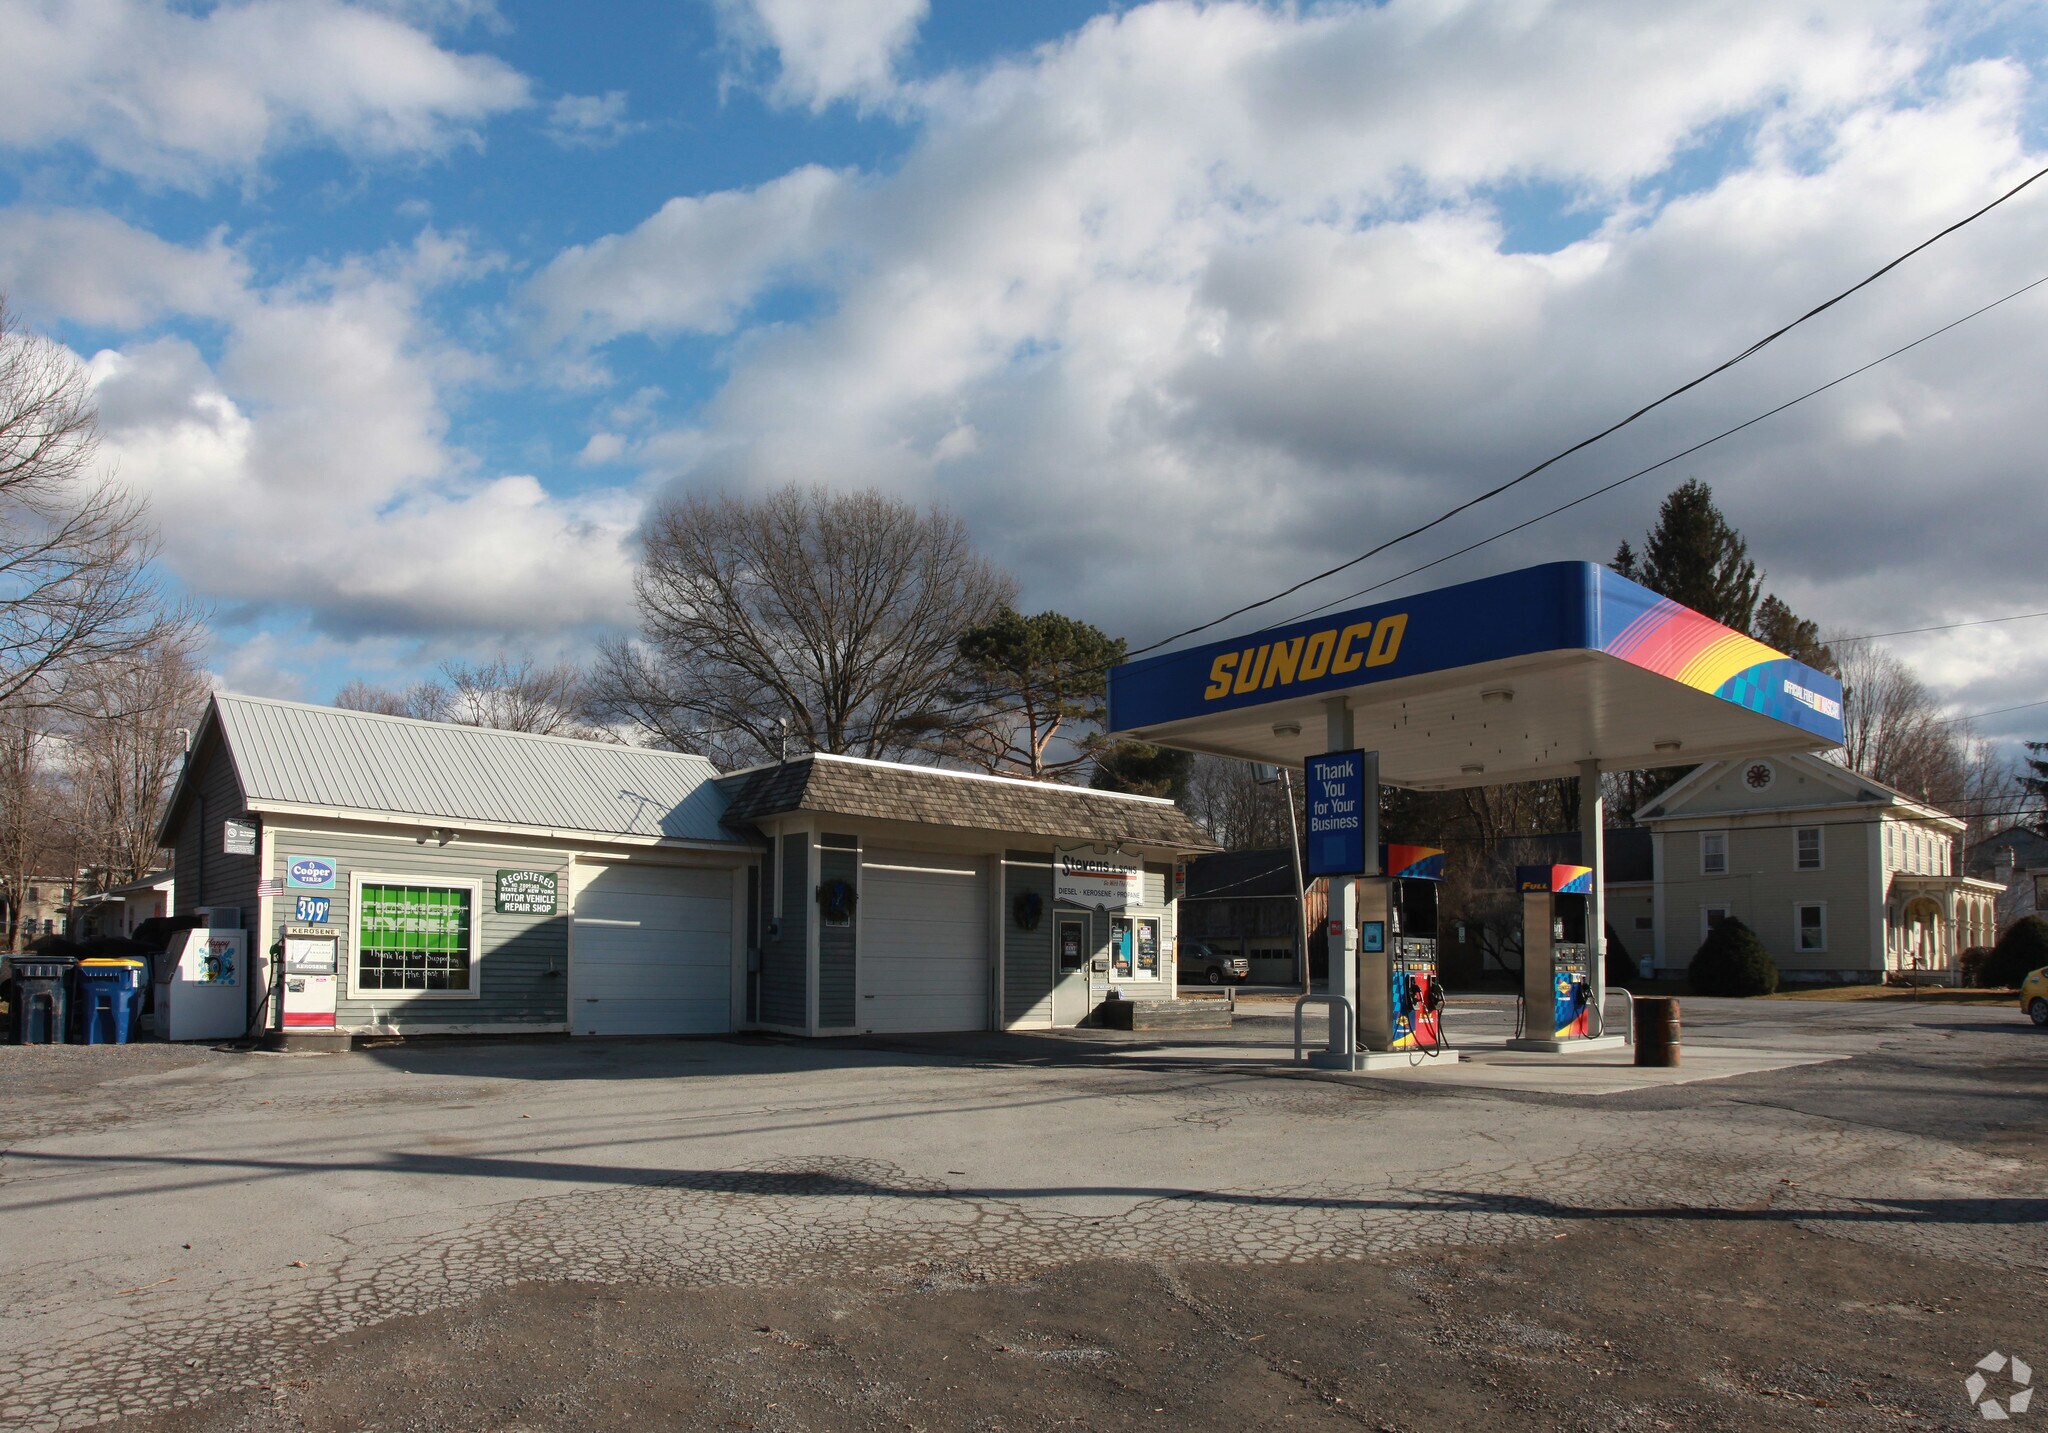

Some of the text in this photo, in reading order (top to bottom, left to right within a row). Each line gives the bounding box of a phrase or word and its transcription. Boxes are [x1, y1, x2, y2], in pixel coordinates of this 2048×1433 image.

[1204, 613, 1409, 700] SUNOCO
[1314, 760, 1354, 781] Thank
[1322, 781, 1345, 798] You
[1314, 798, 1355, 815] for Your
[1311, 814, 1358, 832] Business
[293, 865, 331, 878] Cooper
[1062, 855, 1109, 877] Stevens
[501, 871, 555, 889] REGISTERED
[1521, 881, 1549, 890] FULL
[500, 892, 556, 904] MOTOR VEHICLE
[1058, 887, 1140, 899] DIESEL KEROSENE PROPANE
[504, 902, 552, 913] REPAIR SHOP
[292, 927, 336, 935] KEROSENE
[362, 916, 459, 935] TYRES
[205, 938, 231, 949] Happy
